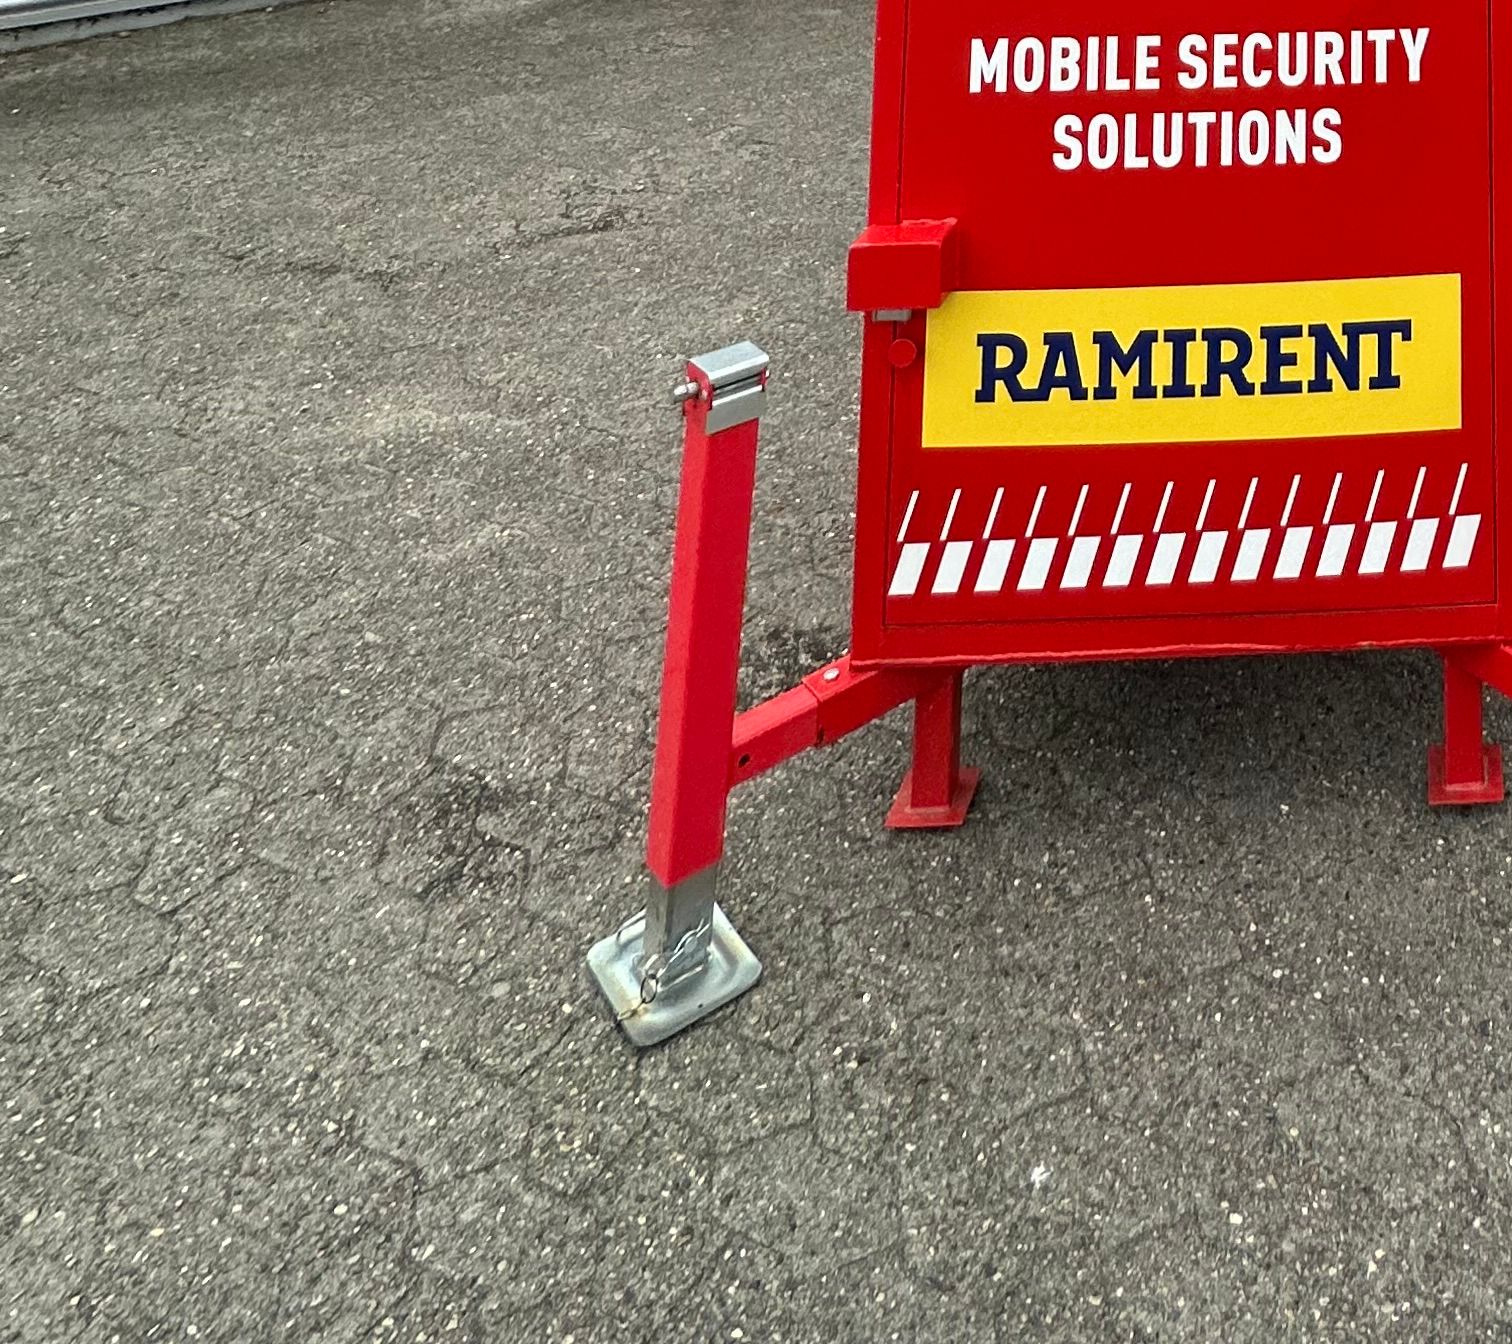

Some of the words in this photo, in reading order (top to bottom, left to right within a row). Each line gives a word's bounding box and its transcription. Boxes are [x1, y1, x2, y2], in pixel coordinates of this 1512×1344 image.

[968, 35, 1162, 94] MOBILE
[1177, 27, 1431, 90] SECURITY
[1052, 107, 1343, 171] SOLUTIONS
[974, 319, 1412, 403] RAMIRENT
